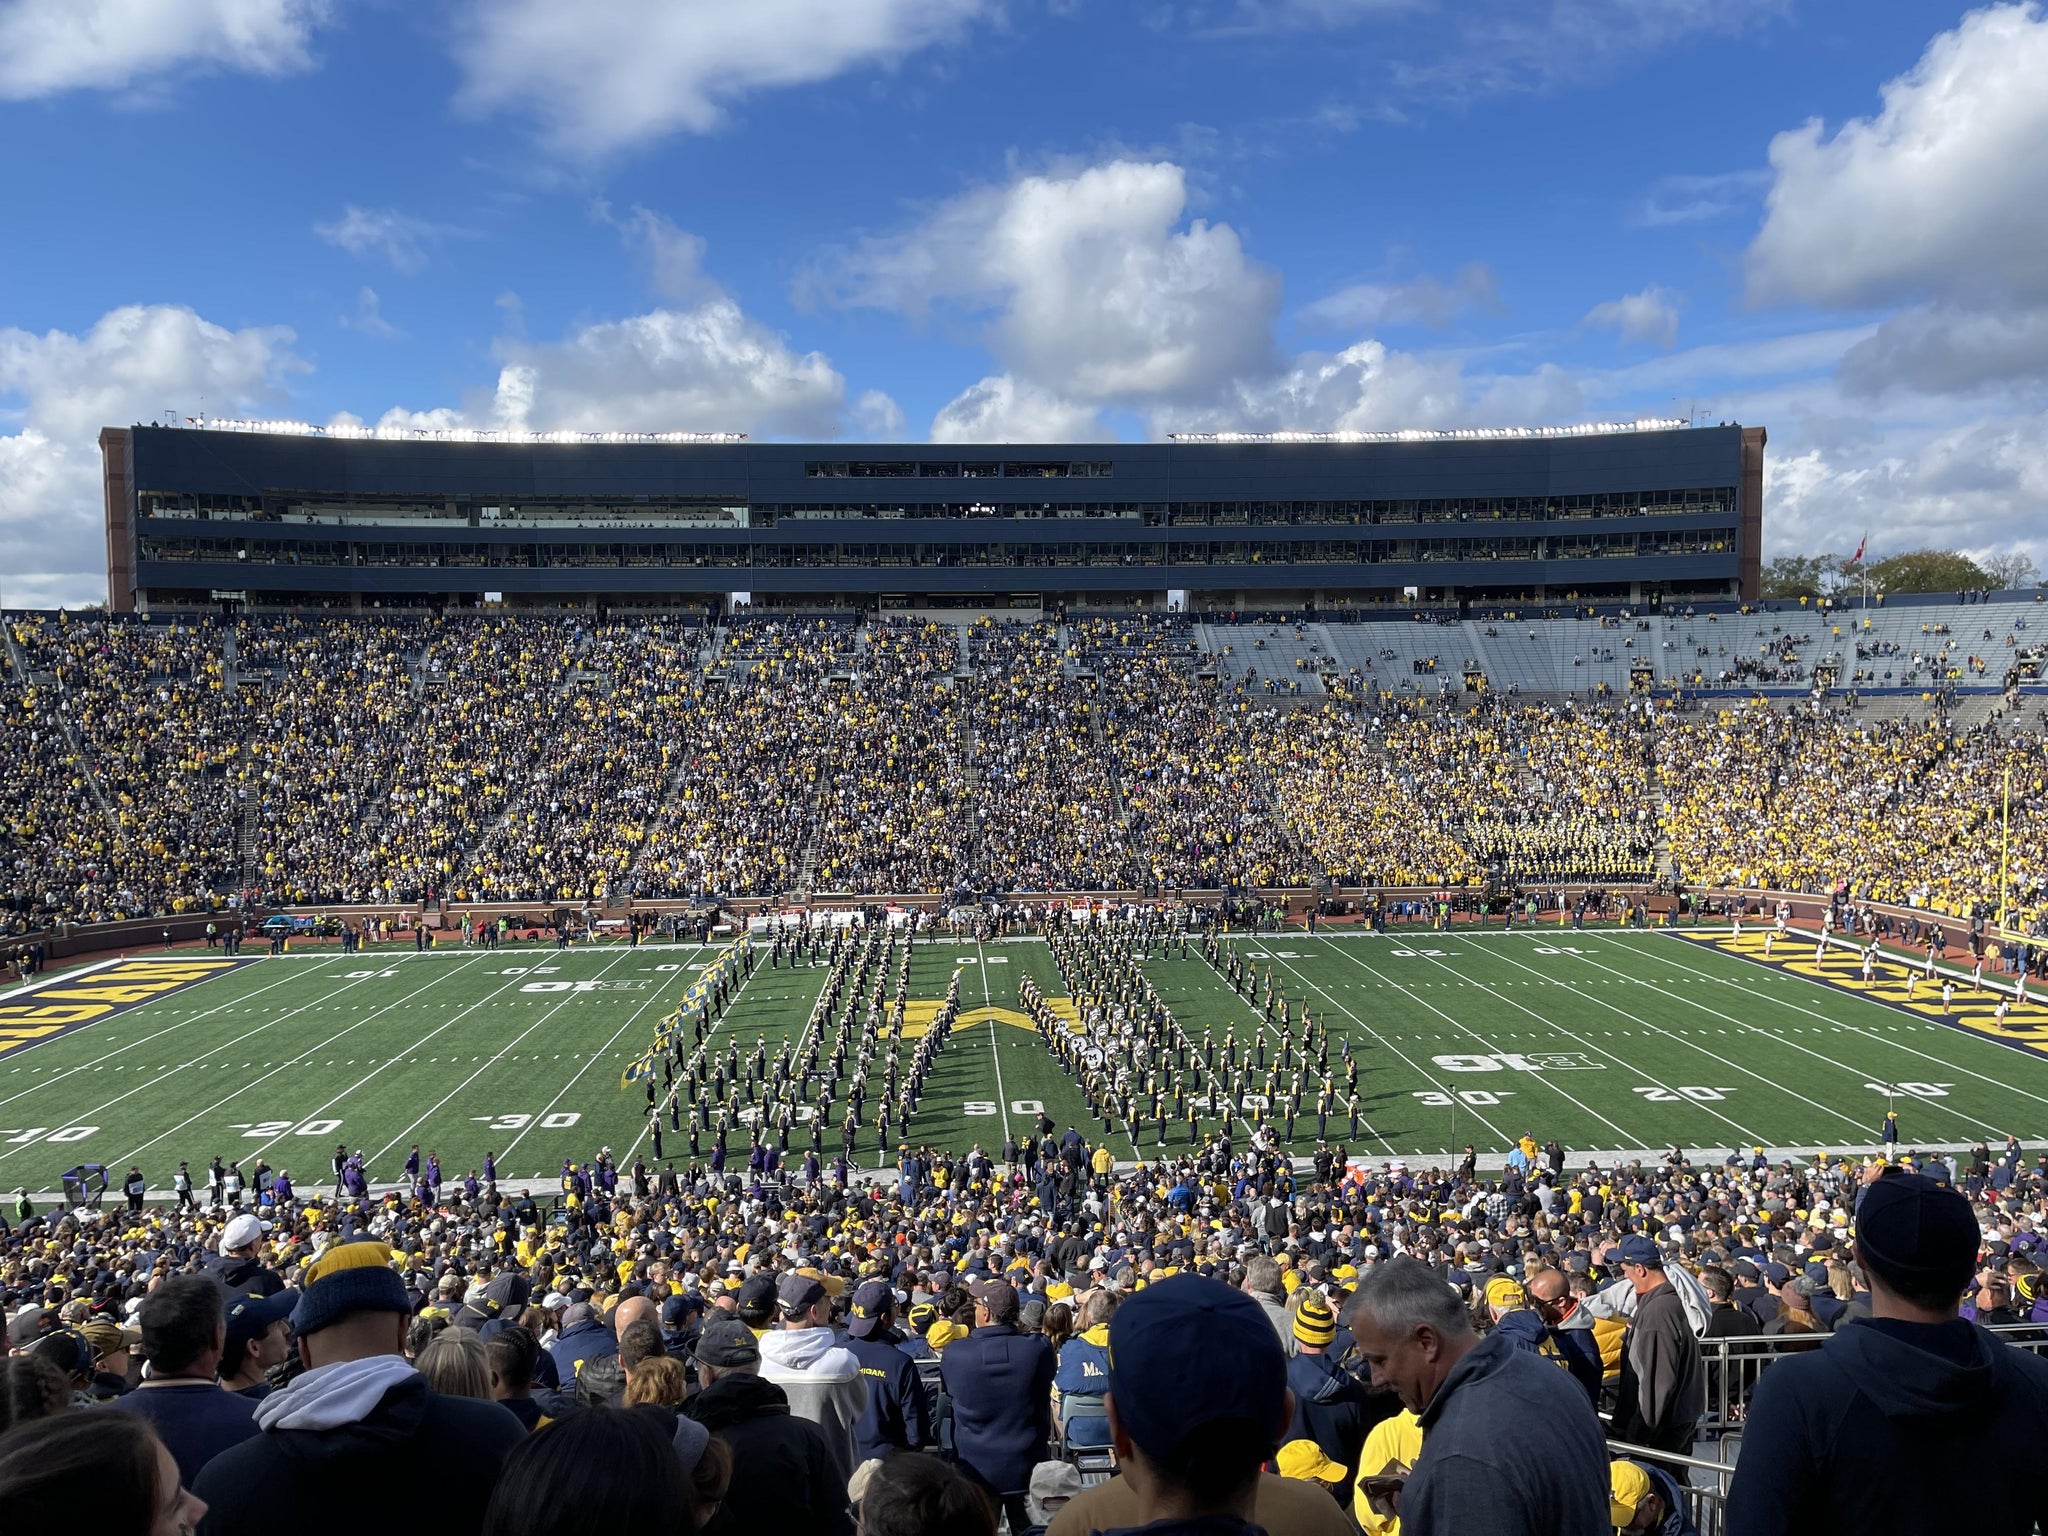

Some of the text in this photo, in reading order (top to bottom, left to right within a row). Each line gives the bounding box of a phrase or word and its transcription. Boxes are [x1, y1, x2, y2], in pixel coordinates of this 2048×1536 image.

[1389, 949, 1448, 957] 20
[1532, 946, 1584, 955] 10
[343, 970, 399, 979] 10
[500, 967, 560, 975] 20
[1632, 1086, 1727, 1101] 20
[1863, 1082, 1950, 1097] 10
[1412, 1090, 1501, 1106] 30
[963, 1101, 1046, 1116] 50
[241, 1119, 344, 1138] 20
[489, 1113, 582, 1130] 30
[5, 1126, 101, 1143] 10
[850, 1302, 866, 1319] M
